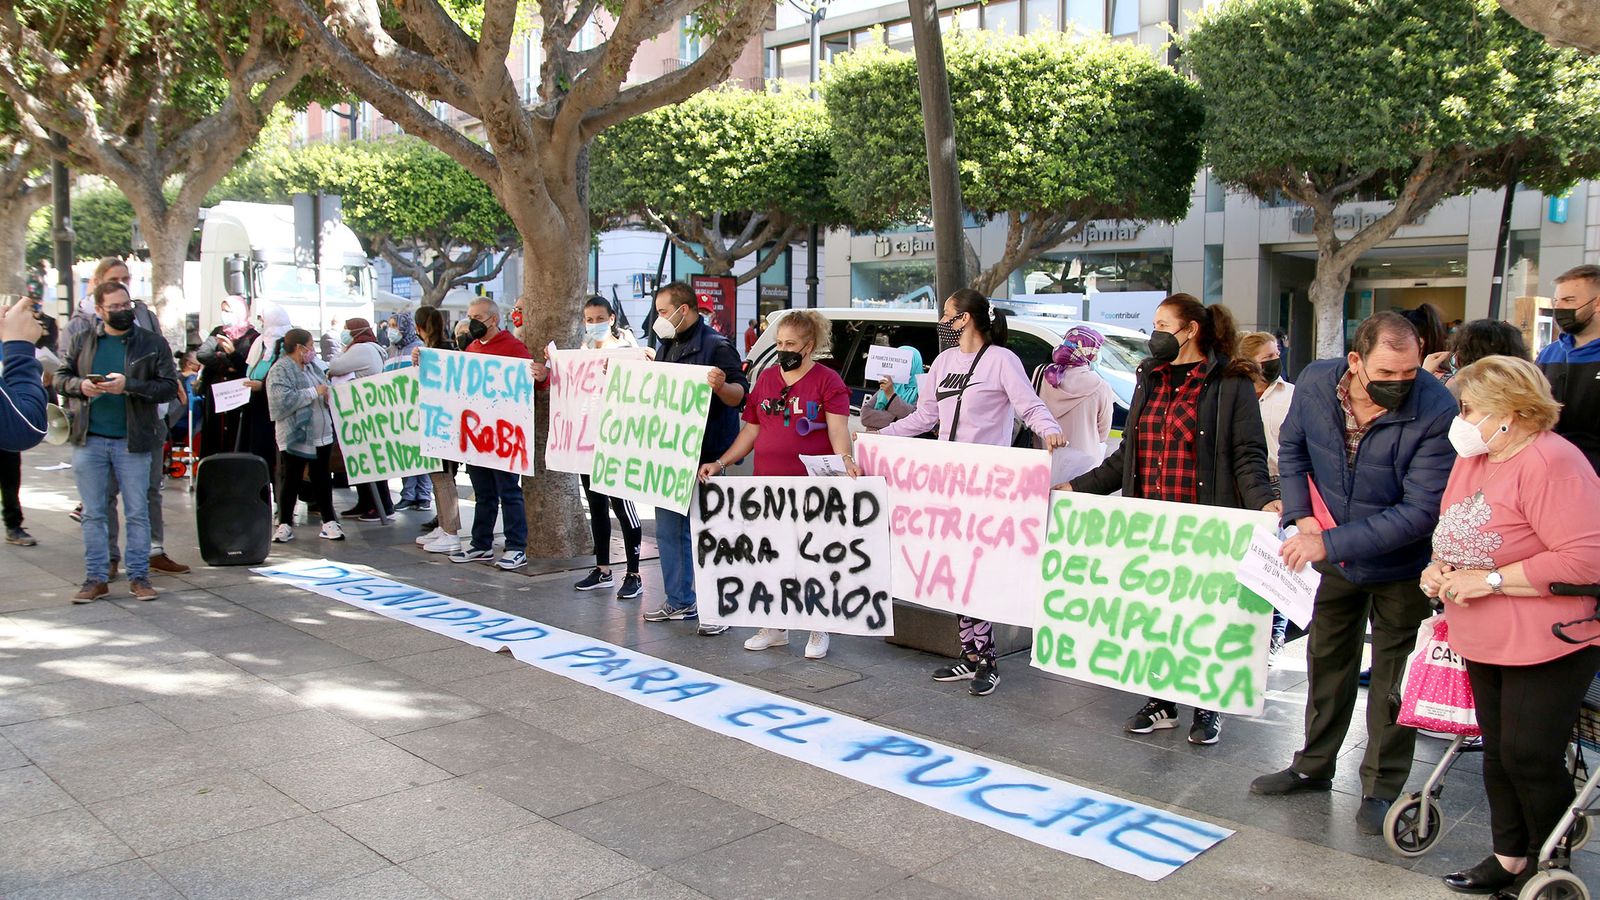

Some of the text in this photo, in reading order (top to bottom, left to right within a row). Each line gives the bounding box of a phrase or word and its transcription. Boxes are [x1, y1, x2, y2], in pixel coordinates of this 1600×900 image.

[893, 236, 936, 256] cajam
[1066, 223, 1137, 247] ajamar
[418, 350, 533, 404] ENDESA
[565, 359, 604, 401] ME
[605, 364, 712, 418] ALCALDE
[341, 408, 419, 446] COMPLIC
[419, 402, 529, 471] TE ROBA
[550, 411, 574, 453] SIN
[346, 452, 371, 478] DE
[592, 451, 621, 487] DE
[699, 482, 880, 528] DIGNIDAD
[697, 528, 872, 574] PARA LOS
[890, 504, 1041, 556] ECTRICAS
[1048, 498, 1254, 561] SUBDELEGAD
[1250, 544, 1258, 552] LA
[1279, 562, 1287, 572] ES
[1262, 563, 1272, 573] NO
[1271, 568, 1280, 578] UN
[716, 570, 889, 631] BARRIOS
[1041, 549, 1109, 586] DEL
[1119, 554, 1274, 615] GOBIER
[1043, 588, 1256, 662] COMPLICE
[1036, 625, 1255, 708] DE ENDESA
[272, 564, 1228, 868] DIGNIDAD PARA EL PUCHE
